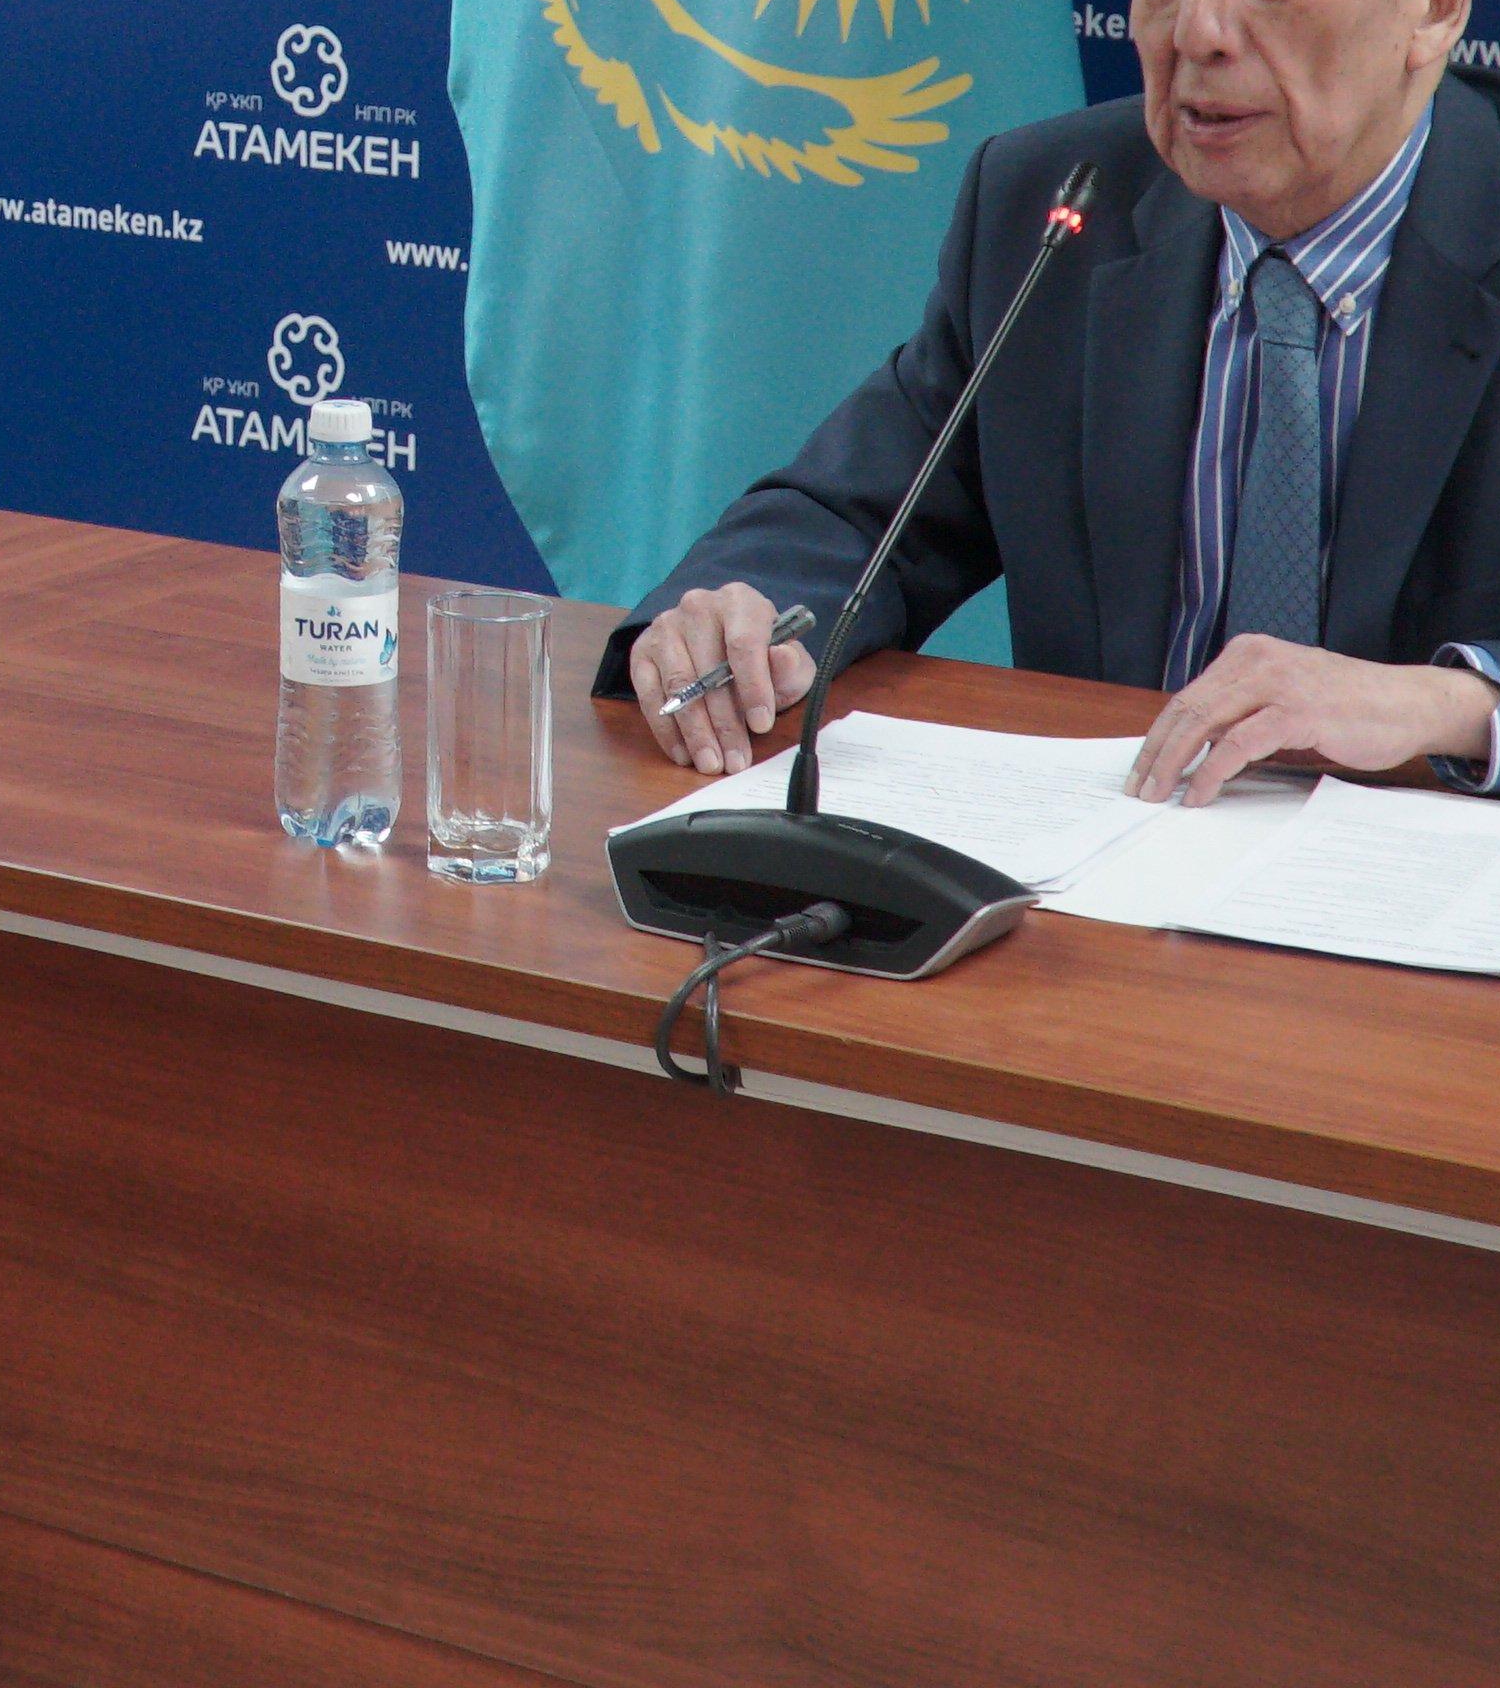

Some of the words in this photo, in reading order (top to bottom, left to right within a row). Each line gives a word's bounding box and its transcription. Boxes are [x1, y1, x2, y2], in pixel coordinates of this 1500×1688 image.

[354, 104, 394, 124] НПП
[394, 106, 418, 126] РК
[193, 119, 421, 180] АТАМЕКЕН
[352, 396, 388, 416] ПП
[390, 400, 414, 419] РК
[294, 617, 379, 641] TURAN
